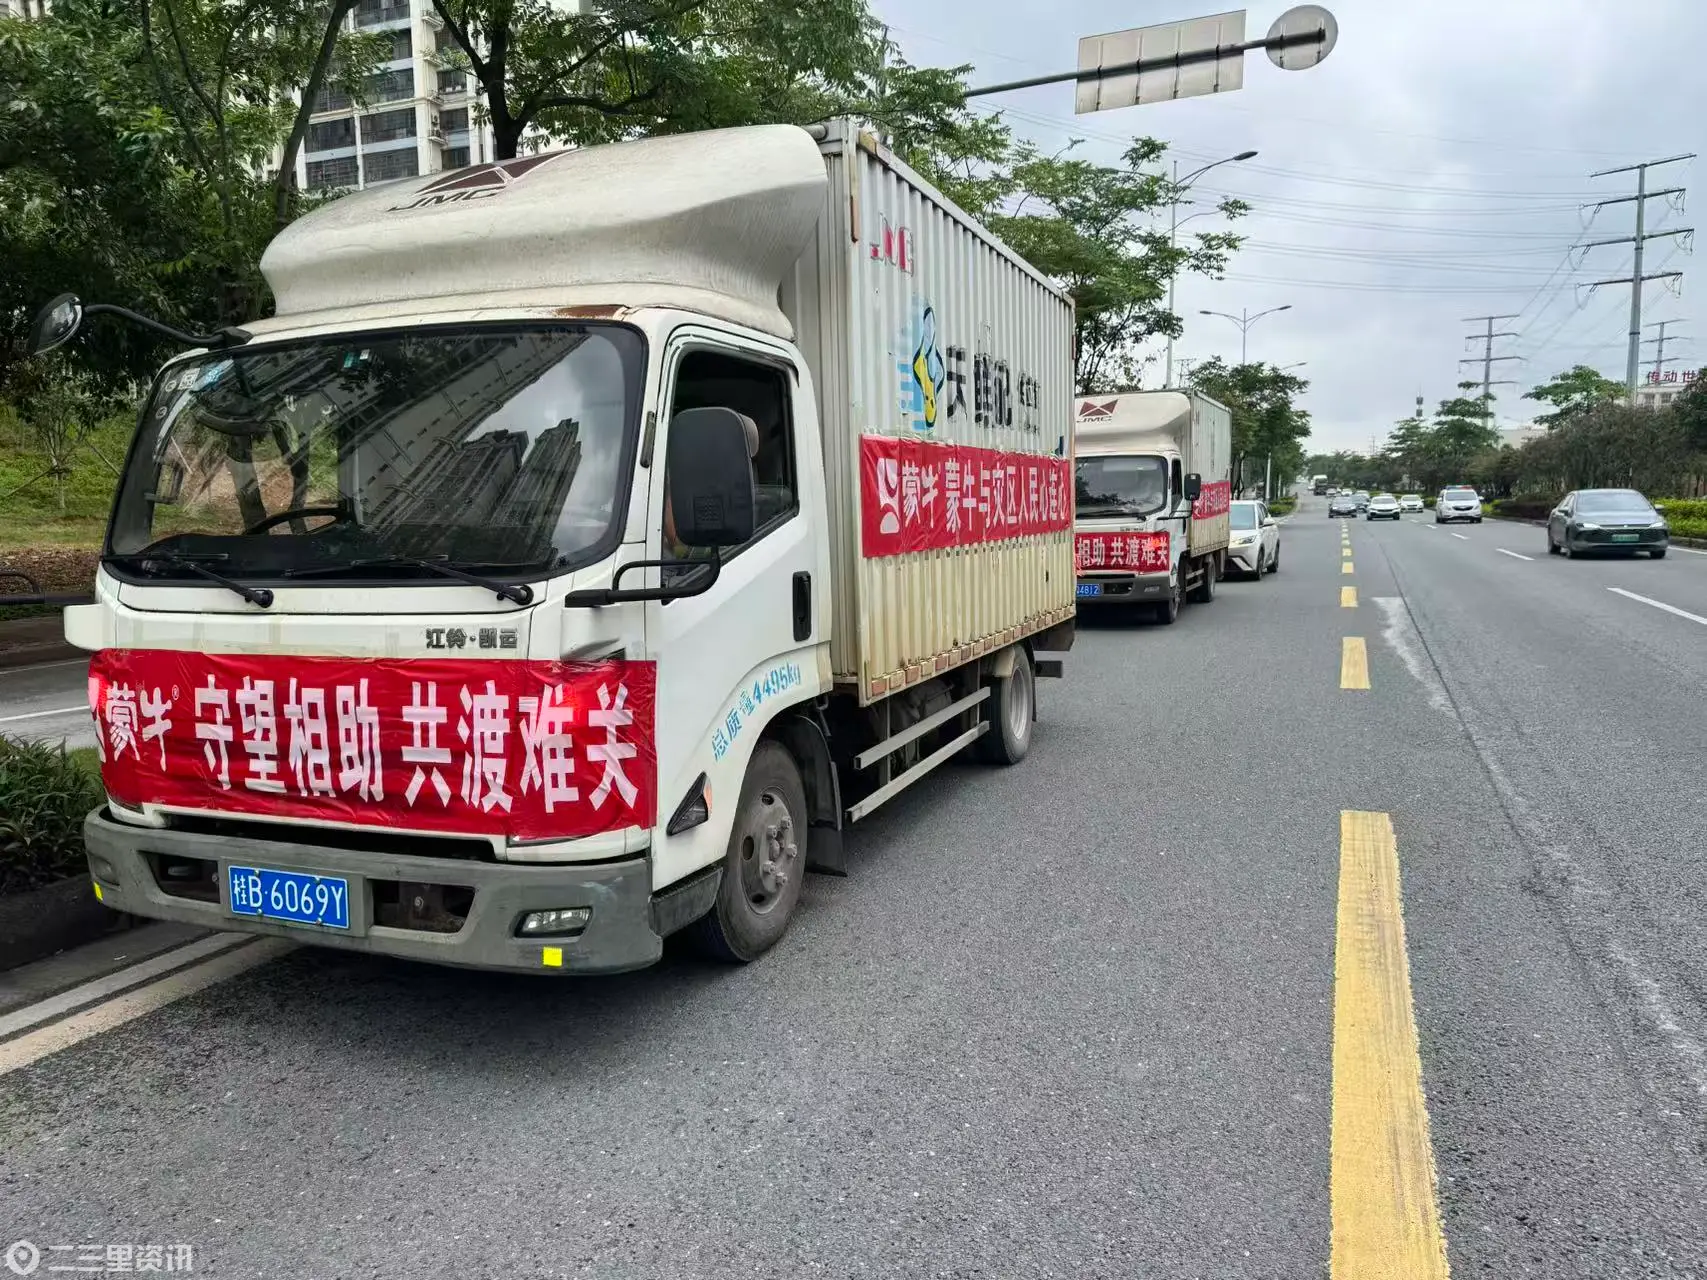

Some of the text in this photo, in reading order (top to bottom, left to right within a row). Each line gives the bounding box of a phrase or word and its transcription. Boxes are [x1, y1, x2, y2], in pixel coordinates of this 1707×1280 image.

[386, 186, 507, 213] JMC
[1110, 535, 1168, 567] 共渡难关
[194, 673, 385, 803] 守望相助
[400, 679, 639, 814] 共渡难关
